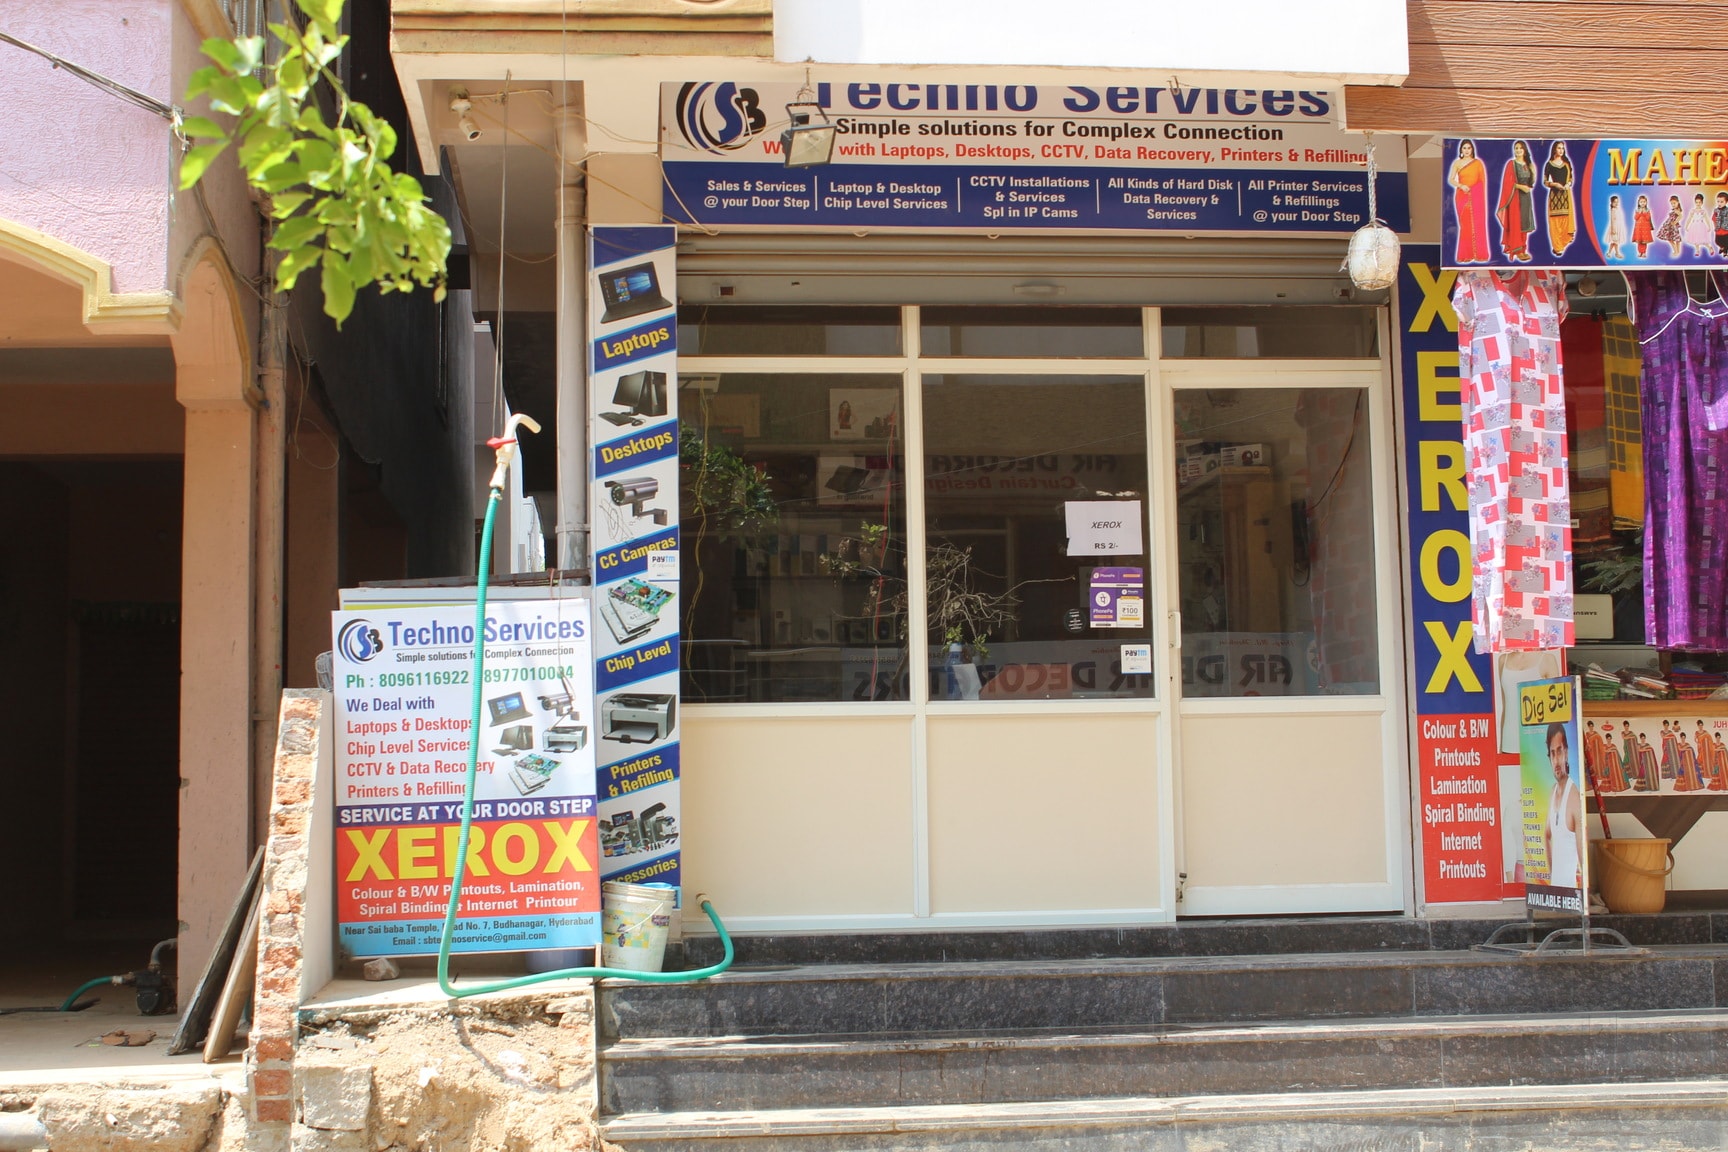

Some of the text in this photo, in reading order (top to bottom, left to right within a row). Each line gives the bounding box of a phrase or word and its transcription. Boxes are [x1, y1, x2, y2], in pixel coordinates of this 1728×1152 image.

[1063, 85, 1330, 117] Services
[836, 118, 1284, 142] Simple solutions for Complex Connection
[763, 140, 787, 155] W
[839, 143, 875, 157] with
[881, 144, 949, 160] Laptops,
[955, 144, 1035, 160] Desktops,
[1041, 144, 1088, 160] CCTV,
[1094, 146, 1131, 160] Data
[1137, 146, 1215, 163] Recovery,
[1220, 147, 1284, 163] Printers
[1289, 149, 1299, 162] &
[1607, 147, 1728, 186] MAHE
[707, 180, 806, 193] Sales & Services
[830, 181, 941, 197] Laptop & Desktop
[970, 175, 1089, 188] CCTV Installations
[1108, 178, 1233, 191] All Kinds of Hard Disk
[1248, 180, 1363, 193] All Printer Services
[704, 196, 810, 211] @ your Door Step
[824, 197, 948, 211] Chip Level Services
[995, 191, 1065, 203] & Services
[1123, 193, 1219, 207] Data Recovery &
[1272, 195, 1340, 208] & Refillings
[983, 206, 1078, 219] Spl in IP Cams
[1147, 209, 1197, 220] Services
[1253, 210, 1360, 224] @ your Door Step
[602, 326, 670, 359] Laptops
[601, 430, 673, 464] Desktops
[1408, 262, 1484, 693] XEROX
[1090, 521, 1122, 529] XEROX
[599, 536, 677, 569] CC Cameras
[387, 615, 586, 647] Techno Services
[396, 651, 426, 664] Simple
[428, 650, 468, 661] solutions
[485, 647, 523, 659] Complex
[525, 645, 574, 658] Connection
[605, 640, 672, 674] Chip Level
[346, 674, 365, 689] Ph
[379, 669, 469, 687] 8096116922
[346, 696, 435, 713] We Deal with
[1522, 683, 1568, 723] Dig Sel
[347, 719, 398, 736] Laptops
[401, 718, 411, 732] &
[1423, 719, 1489, 739] Colour & B/W
[347, 740, 376, 758] Chip
[379, 739, 414, 755] Level
[1434, 748, 1481, 767] Printouts
[347, 759, 495, 777] CCTV & Data Recoery
[610, 754, 662, 780] Printers
[347, 784, 399, 799] Printers
[403, 782, 412, 796] &
[608, 766, 675, 797] & Refilling
[1430, 776, 1487, 795] Lamination
[340, 806, 413, 823] SERVICE
[417, 805, 440, 820] AT
[497, 801, 545, 817] DOOR
[550, 798, 593, 814] STEP
[1425, 803, 1495, 826] Spiral Binding
[345, 819, 593, 882] XEROX
[1441, 831, 1482, 851] Internet
[611, 858, 678, 884] cessories
[1440, 860, 1486, 879] Printouts
[351, 880, 585, 900] Colour & B/W Pntouts, Lamination,
[359, 903, 397, 918] Spiral
[467, 898, 518, 911] Internet
[525, 896, 578, 909] Printour
[1527, 893, 1581, 911] AVAILABLE HERE
[344, 916, 594, 936] Near Sai baba Temple, ad No. 7, Budhanagar, Hyderabad
[392, 935, 416, 946] Email
[423, 931, 547, 946] sbtenoservice@gmail.com
